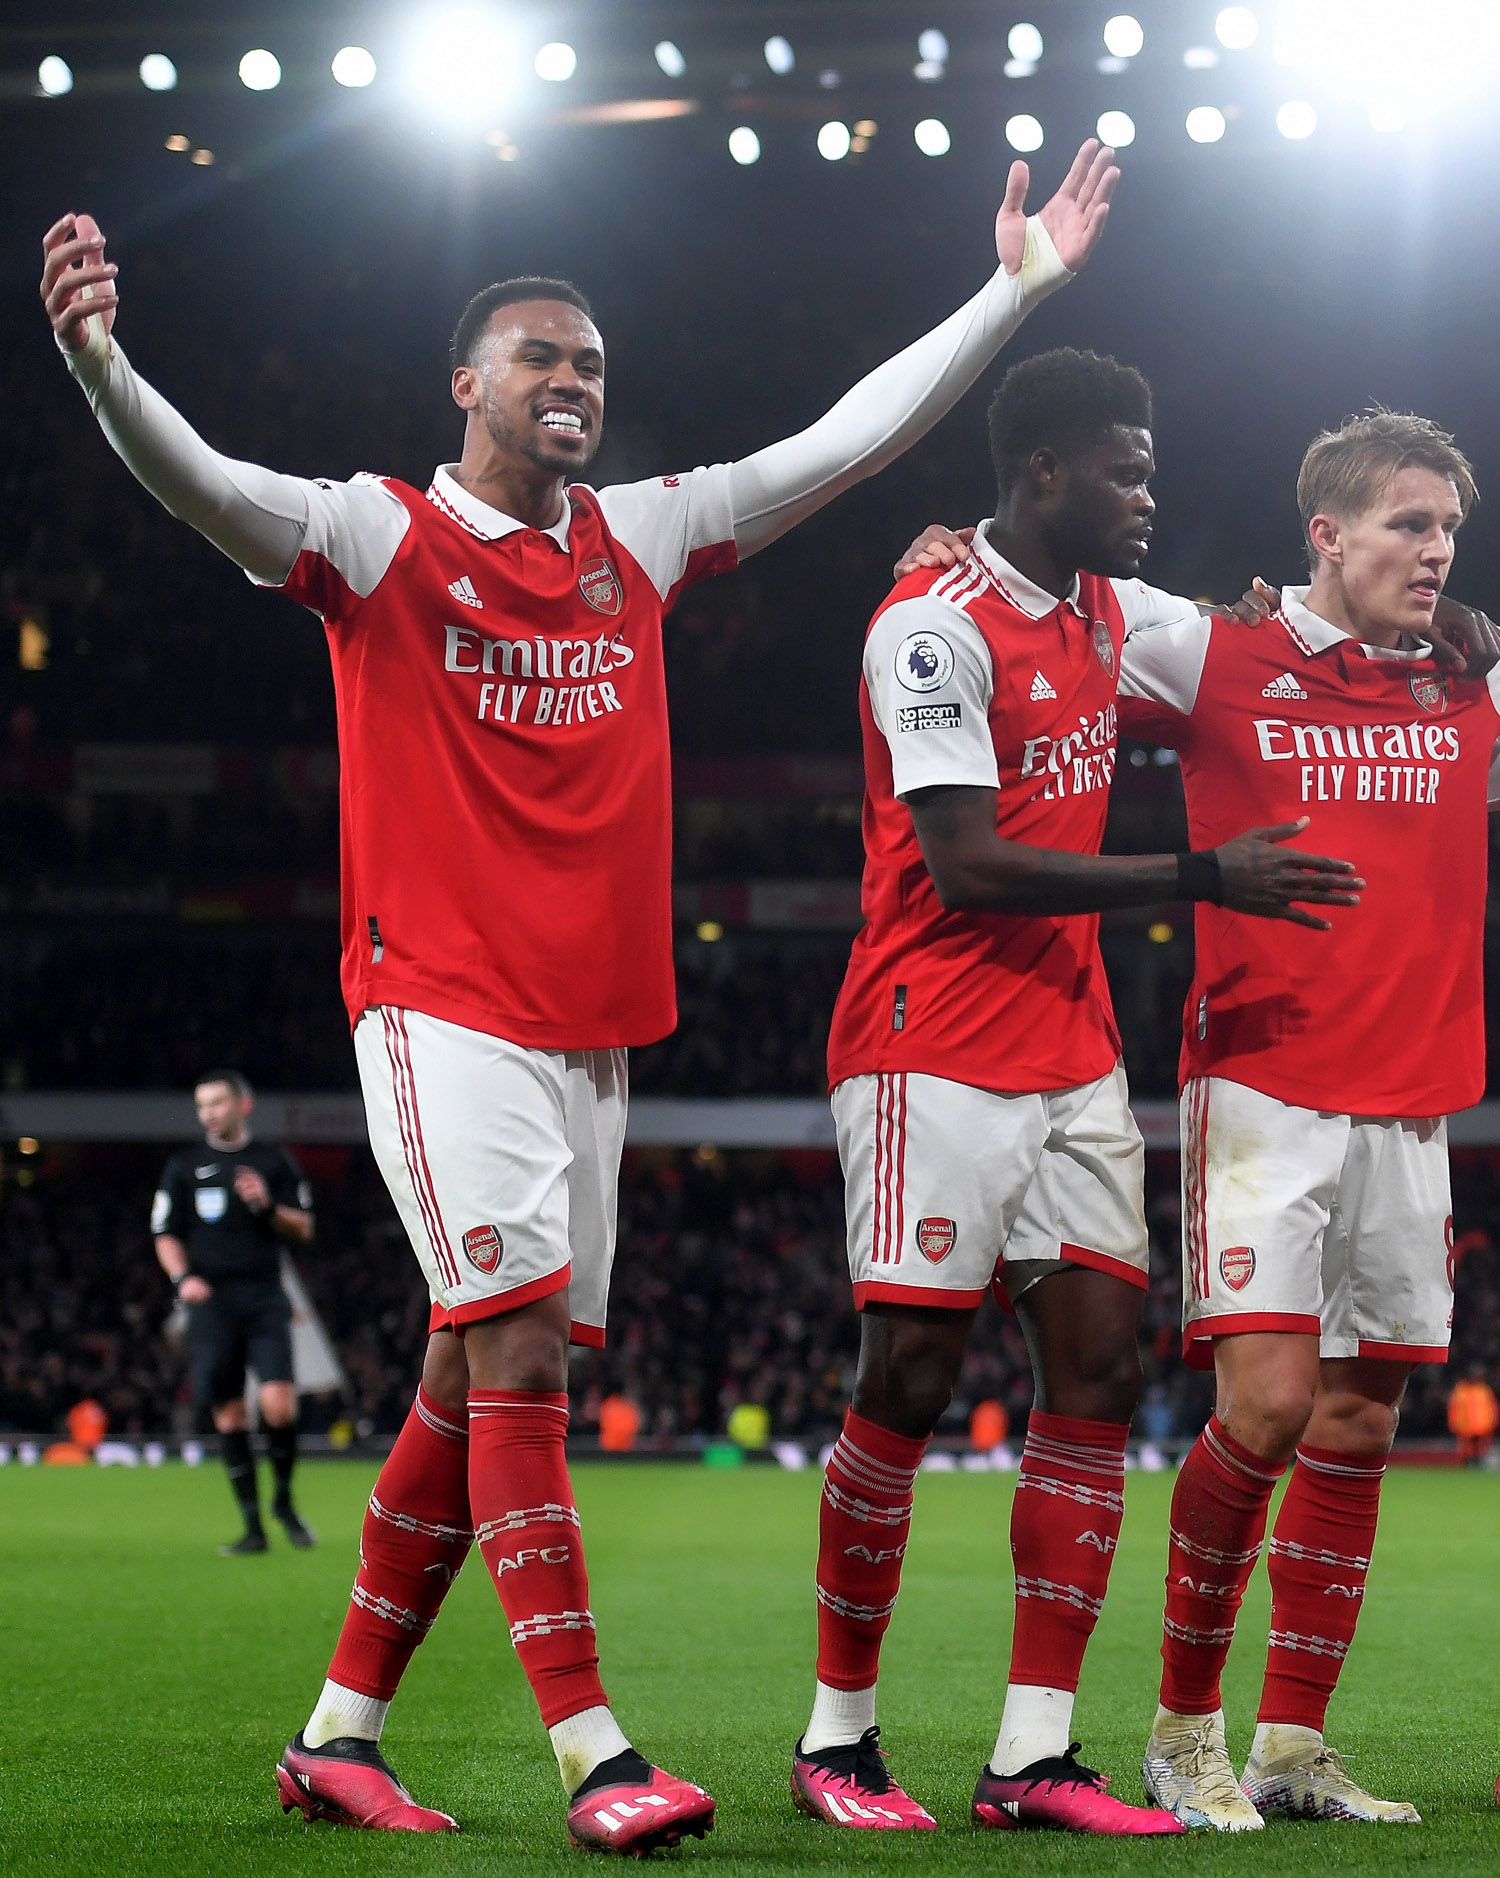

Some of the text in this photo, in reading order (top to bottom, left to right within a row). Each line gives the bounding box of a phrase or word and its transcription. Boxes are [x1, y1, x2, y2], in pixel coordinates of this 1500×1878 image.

[580, 566, 608, 585] Arsenal
[444, 624, 634, 679] Emirats
[1261, 687, 1308, 700] adidas
[477, 681, 623, 726] FLY BETTER
[896, 706, 954, 721] No room
[897, 716, 961, 733] for racism
[1252, 719, 1460, 761] Emirates
[1301, 765, 1440, 804] FLY BETTER
[921, 1223, 951, 1233] Arsenal
[467, 1230, 495, 1246] Arsenal
[1223, 1253, 1251, 1263] Arsenal
[1075, 1530, 1117, 1554] AF
[497, 1545, 569, 1578] AFC
[1323, 1583, 1365, 1599] AF
